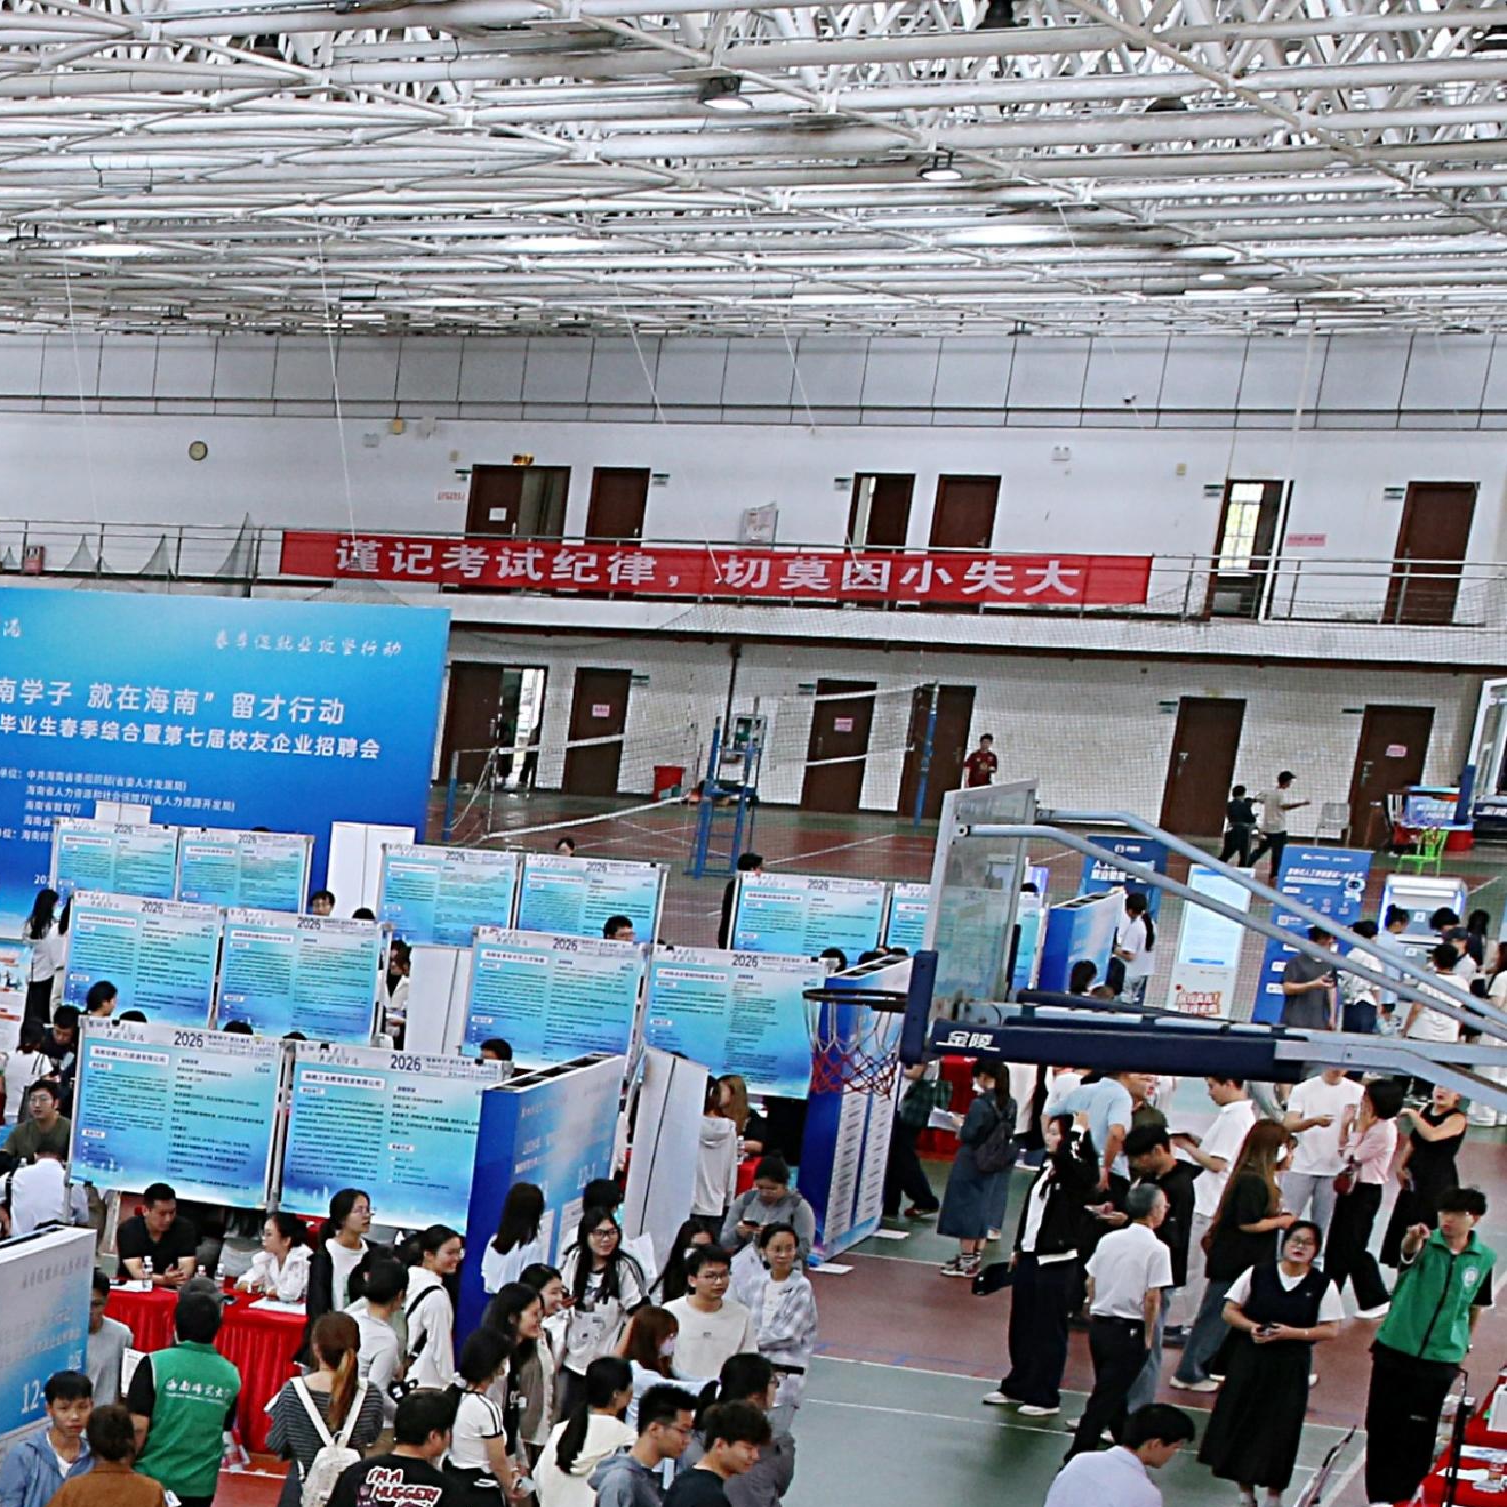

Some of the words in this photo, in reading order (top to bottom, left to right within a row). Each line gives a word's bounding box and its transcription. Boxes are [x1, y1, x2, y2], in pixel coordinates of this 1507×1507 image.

[87, 682, 215, 716] 就在海南”
[231, 691, 346, 726] 留才行动
[142, 902, 163, 913] 2026
[298, 918, 321, 930] 2026
[553, 939, 578, 951] 2026
[733, 954, 759, 967] 2026
[174, 1032, 204, 1048] 2026
[391, 1054, 422, 1073] 2026
[21, 1379, 46, 1415] 12-
